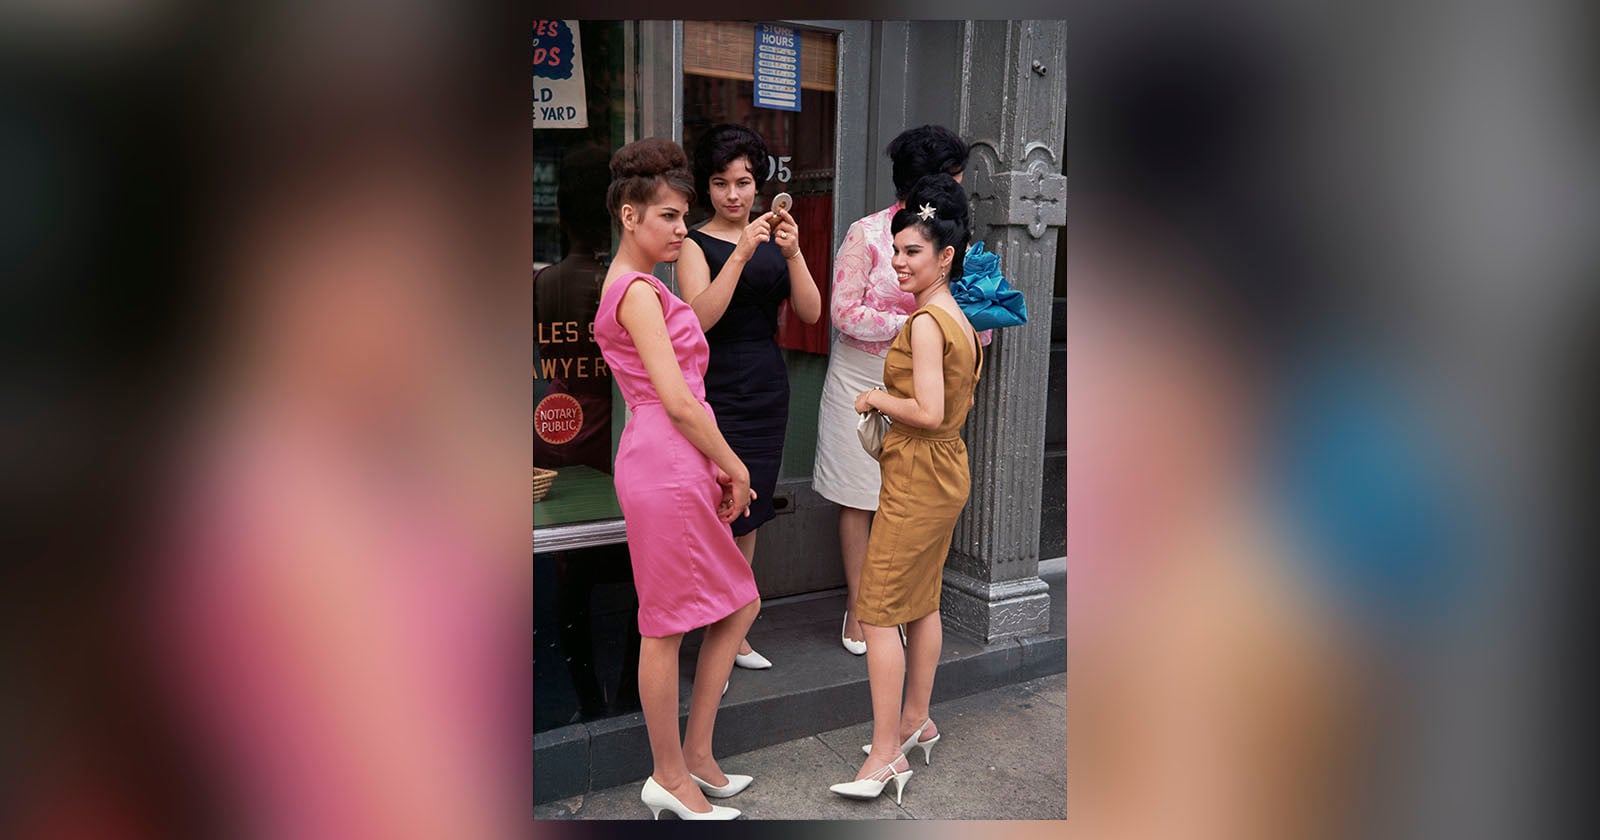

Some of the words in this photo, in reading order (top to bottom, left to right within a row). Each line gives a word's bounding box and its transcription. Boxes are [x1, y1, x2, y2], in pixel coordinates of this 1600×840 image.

[762, 33, 794, 47] HOURS
[540, 106, 577, 120] YARD
[538, 321, 579, 344] LES
[540, 407, 577, 421] NOTARY
[541, 419, 577, 433] PUBLIC
